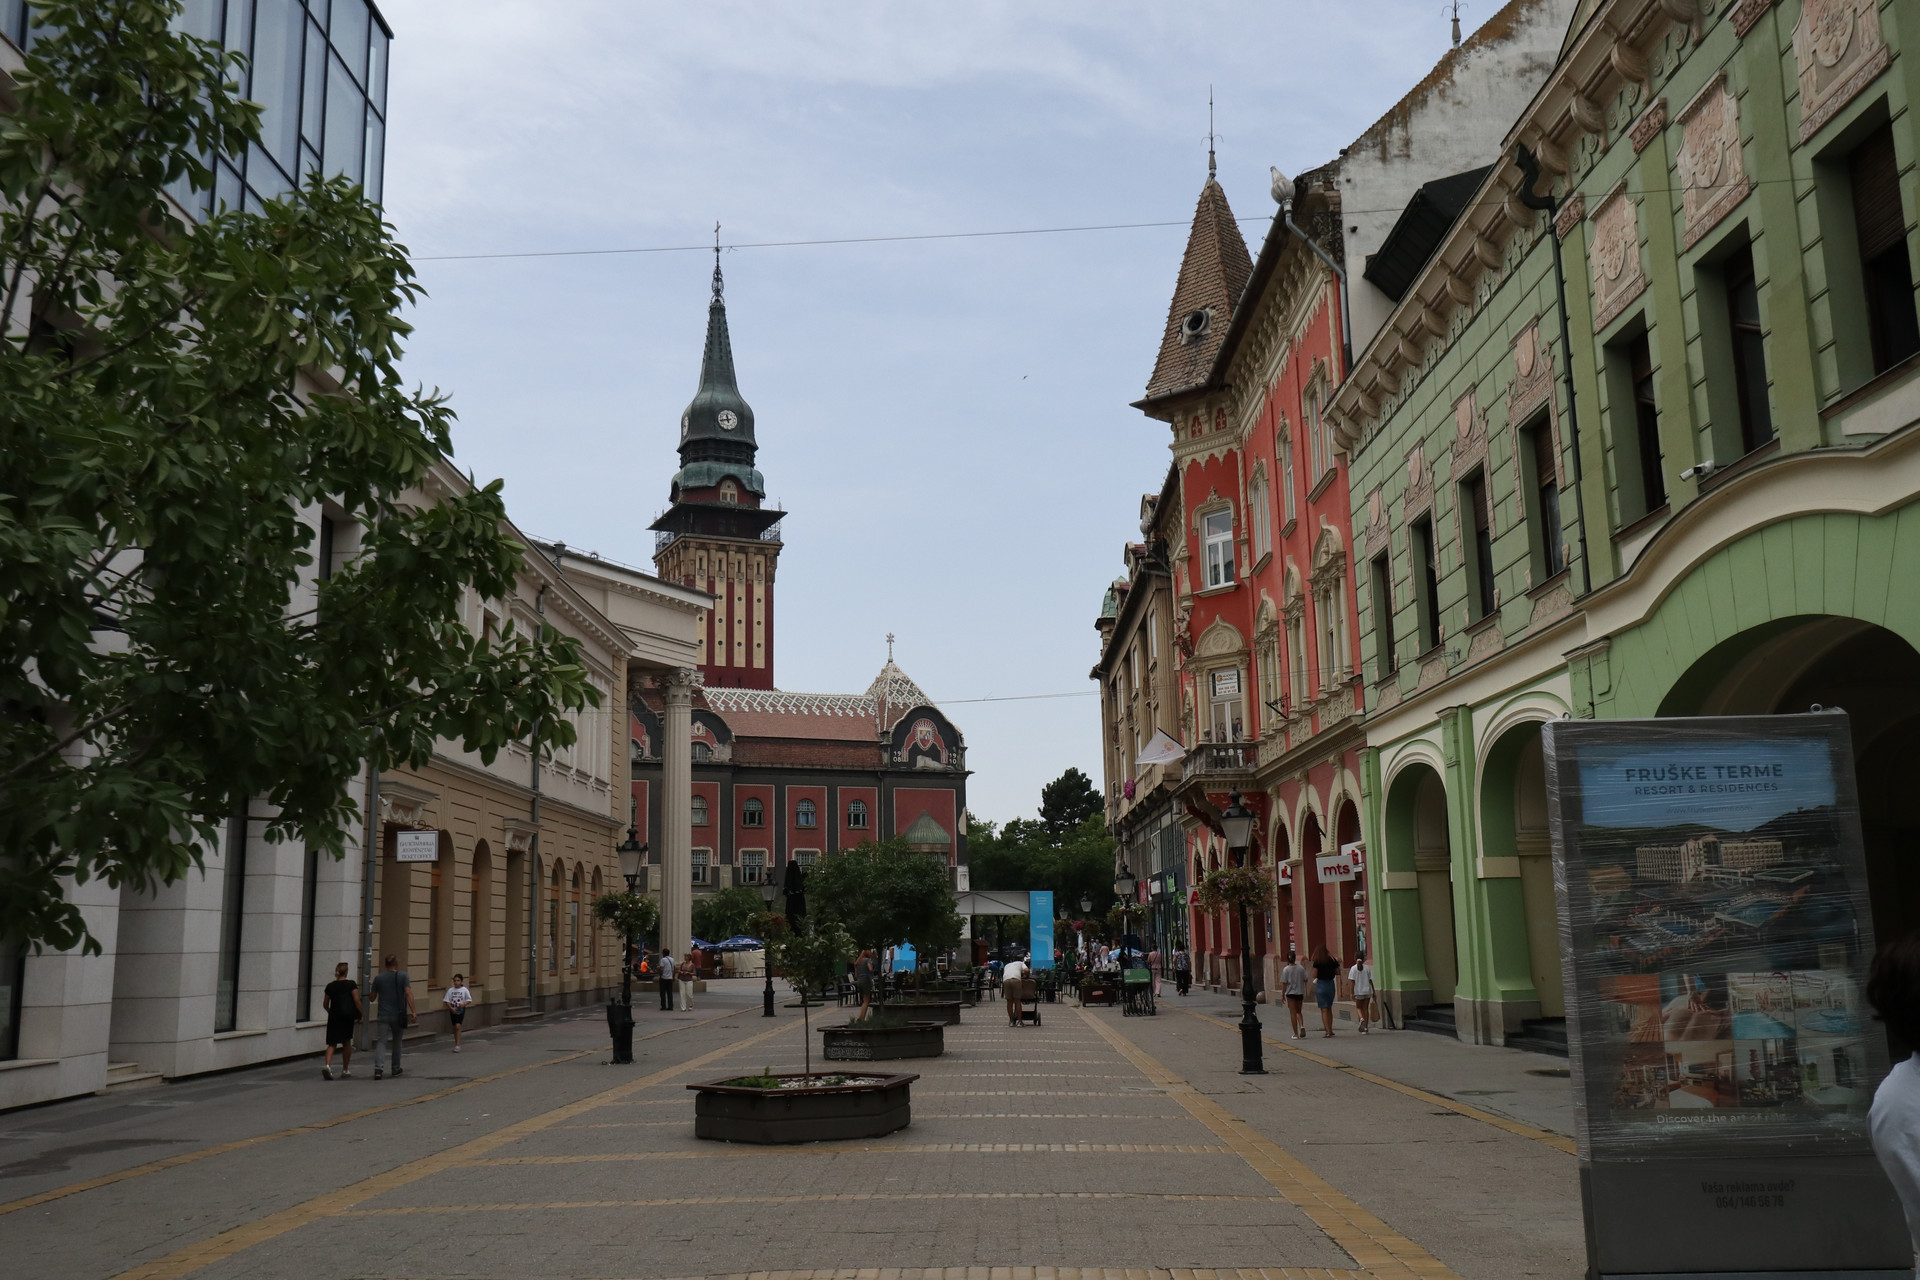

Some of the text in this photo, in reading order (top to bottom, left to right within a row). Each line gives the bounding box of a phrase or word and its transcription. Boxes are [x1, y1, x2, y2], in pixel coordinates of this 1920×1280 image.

[1625, 764, 1784, 782] FRUŠKE TERME
[1634, 783, 1778, 796] RESORT & RESIDENCES
[1323, 863, 1350, 876] mts
[1656, 1114, 1704, 1124] Discover
[1707, 1113, 1727, 1123] the
[1702, 1180, 1794, 1193] Vaša reklama ovde?
[1716, 1196, 1756, 1208] 064/146
[1771, 1195, 1784, 1207] 78
